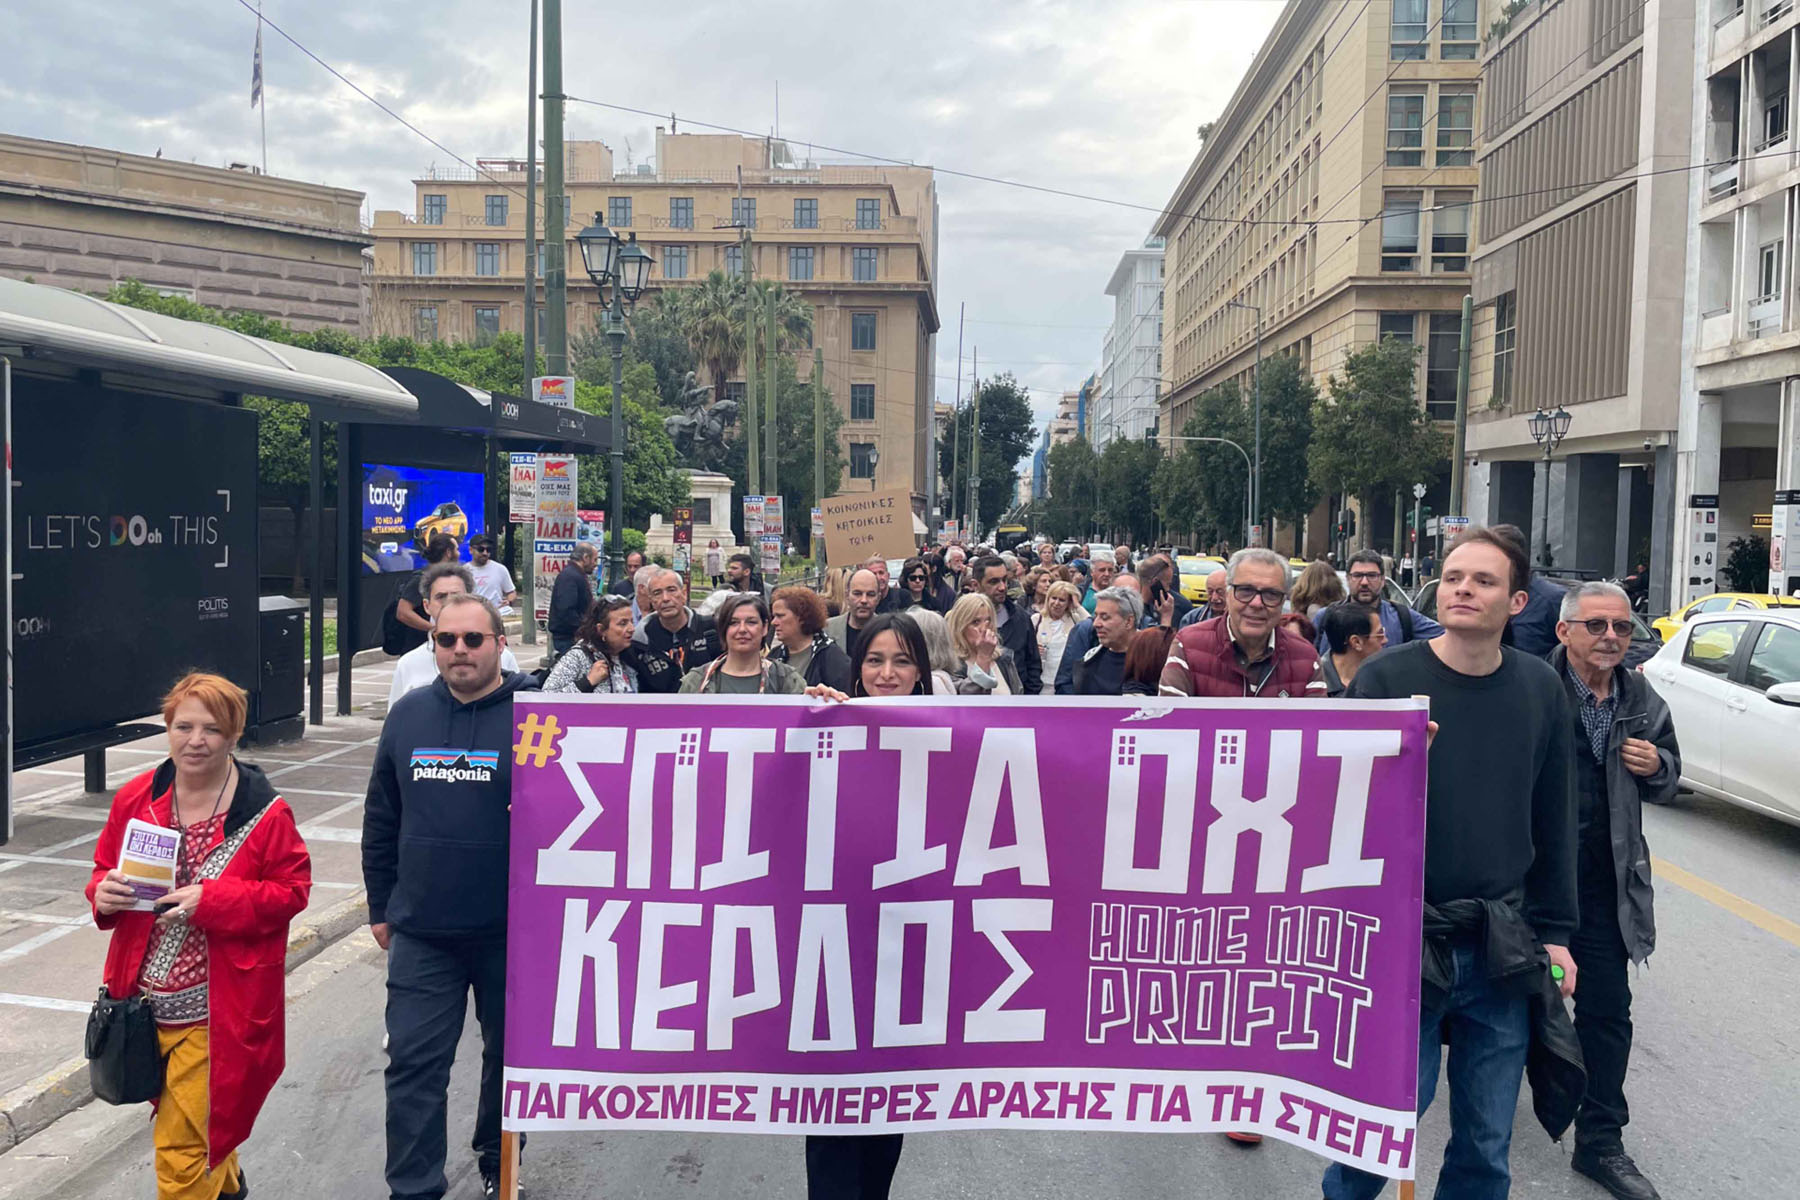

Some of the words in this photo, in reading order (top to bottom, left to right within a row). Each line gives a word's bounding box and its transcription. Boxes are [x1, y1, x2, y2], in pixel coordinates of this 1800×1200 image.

[369, 482, 408, 513] taxi.gr
[827, 498, 895, 516] ΚΟΙΝΩΝΙΚΕΣ
[28, 515, 101, 549] LET'S
[169, 516, 218, 545] THIS
[836, 514, 893, 531] ΚΑΤΟΙΚΙΕΣ
[198, 597, 229, 611] POLITIS
[413, 766, 491, 783] patagonia
[1101, 728, 1402, 895] ΟΧΙ
[1089, 902, 1250, 965] HOME
[1265, 905, 1381, 981] NOT
[551, 898, 1054, 1053] ΚΕΡΔΟΣ
[1085, 966, 1374, 1069] PROFIT
[503, 1080, 759, 1121] ΠΑΓΚΟΣΜΙΕΣ
[769, 1083, 940, 1124] ΗΜΕΡΕΣ
[948, 1081, 1116, 1121] ΔΡΑΣΗΣ
[1126, 1083, 1192, 1123] ΓΙΑ
[1205, 1085, 1265, 1123] ΤΗ
[1275, 1092, 1416, 1169] ΣΤΕΓΗ
